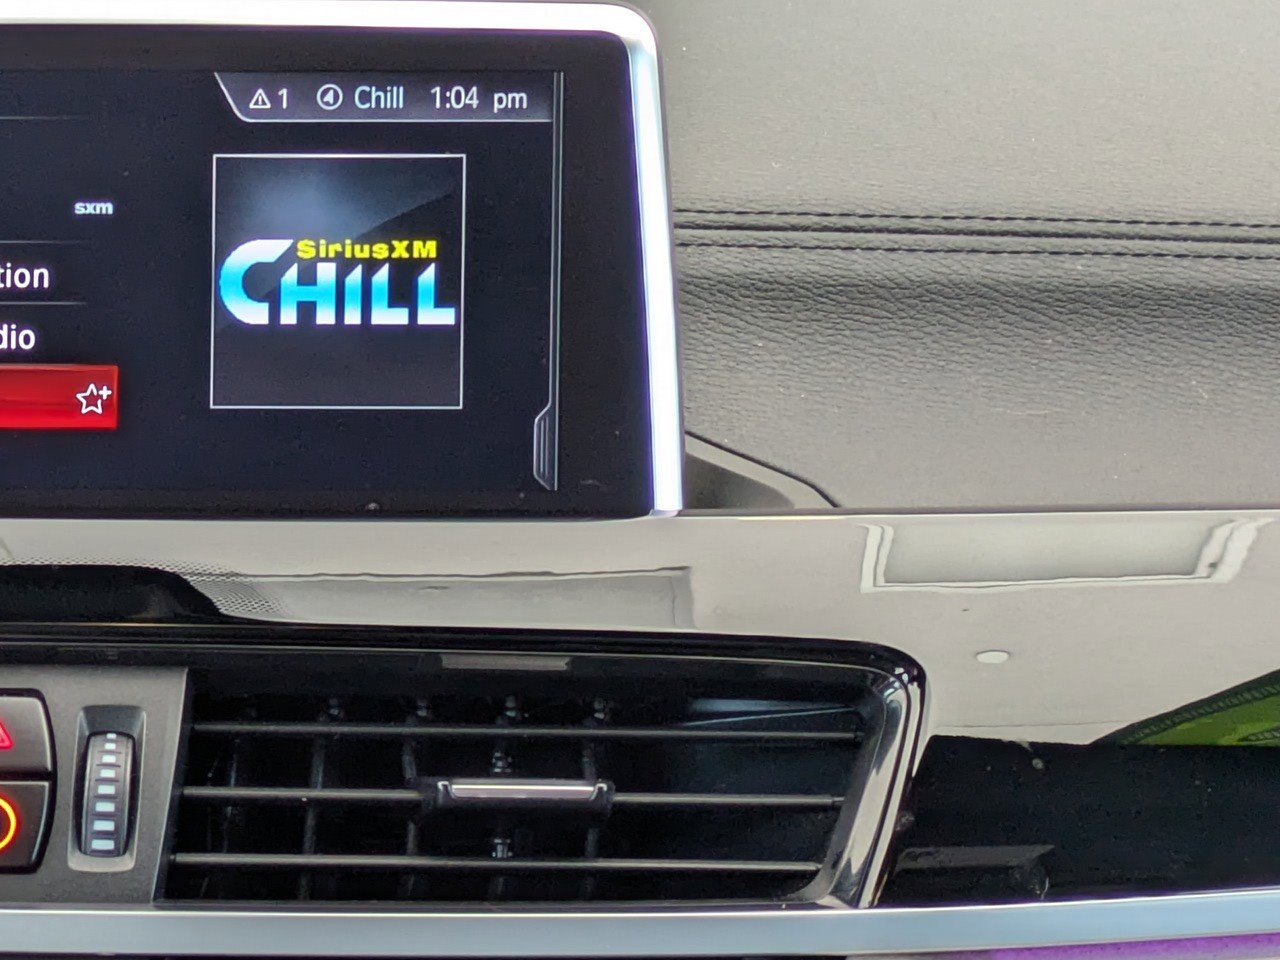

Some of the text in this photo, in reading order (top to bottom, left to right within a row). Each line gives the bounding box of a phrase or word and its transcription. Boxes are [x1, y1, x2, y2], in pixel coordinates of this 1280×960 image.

[355, 86, 403, 109] Chill
[431, 86, 527, 115] 1:04 pm
[75, 202, 113, 215] sxm
[297, 239, 437, 259] SiriusXM
